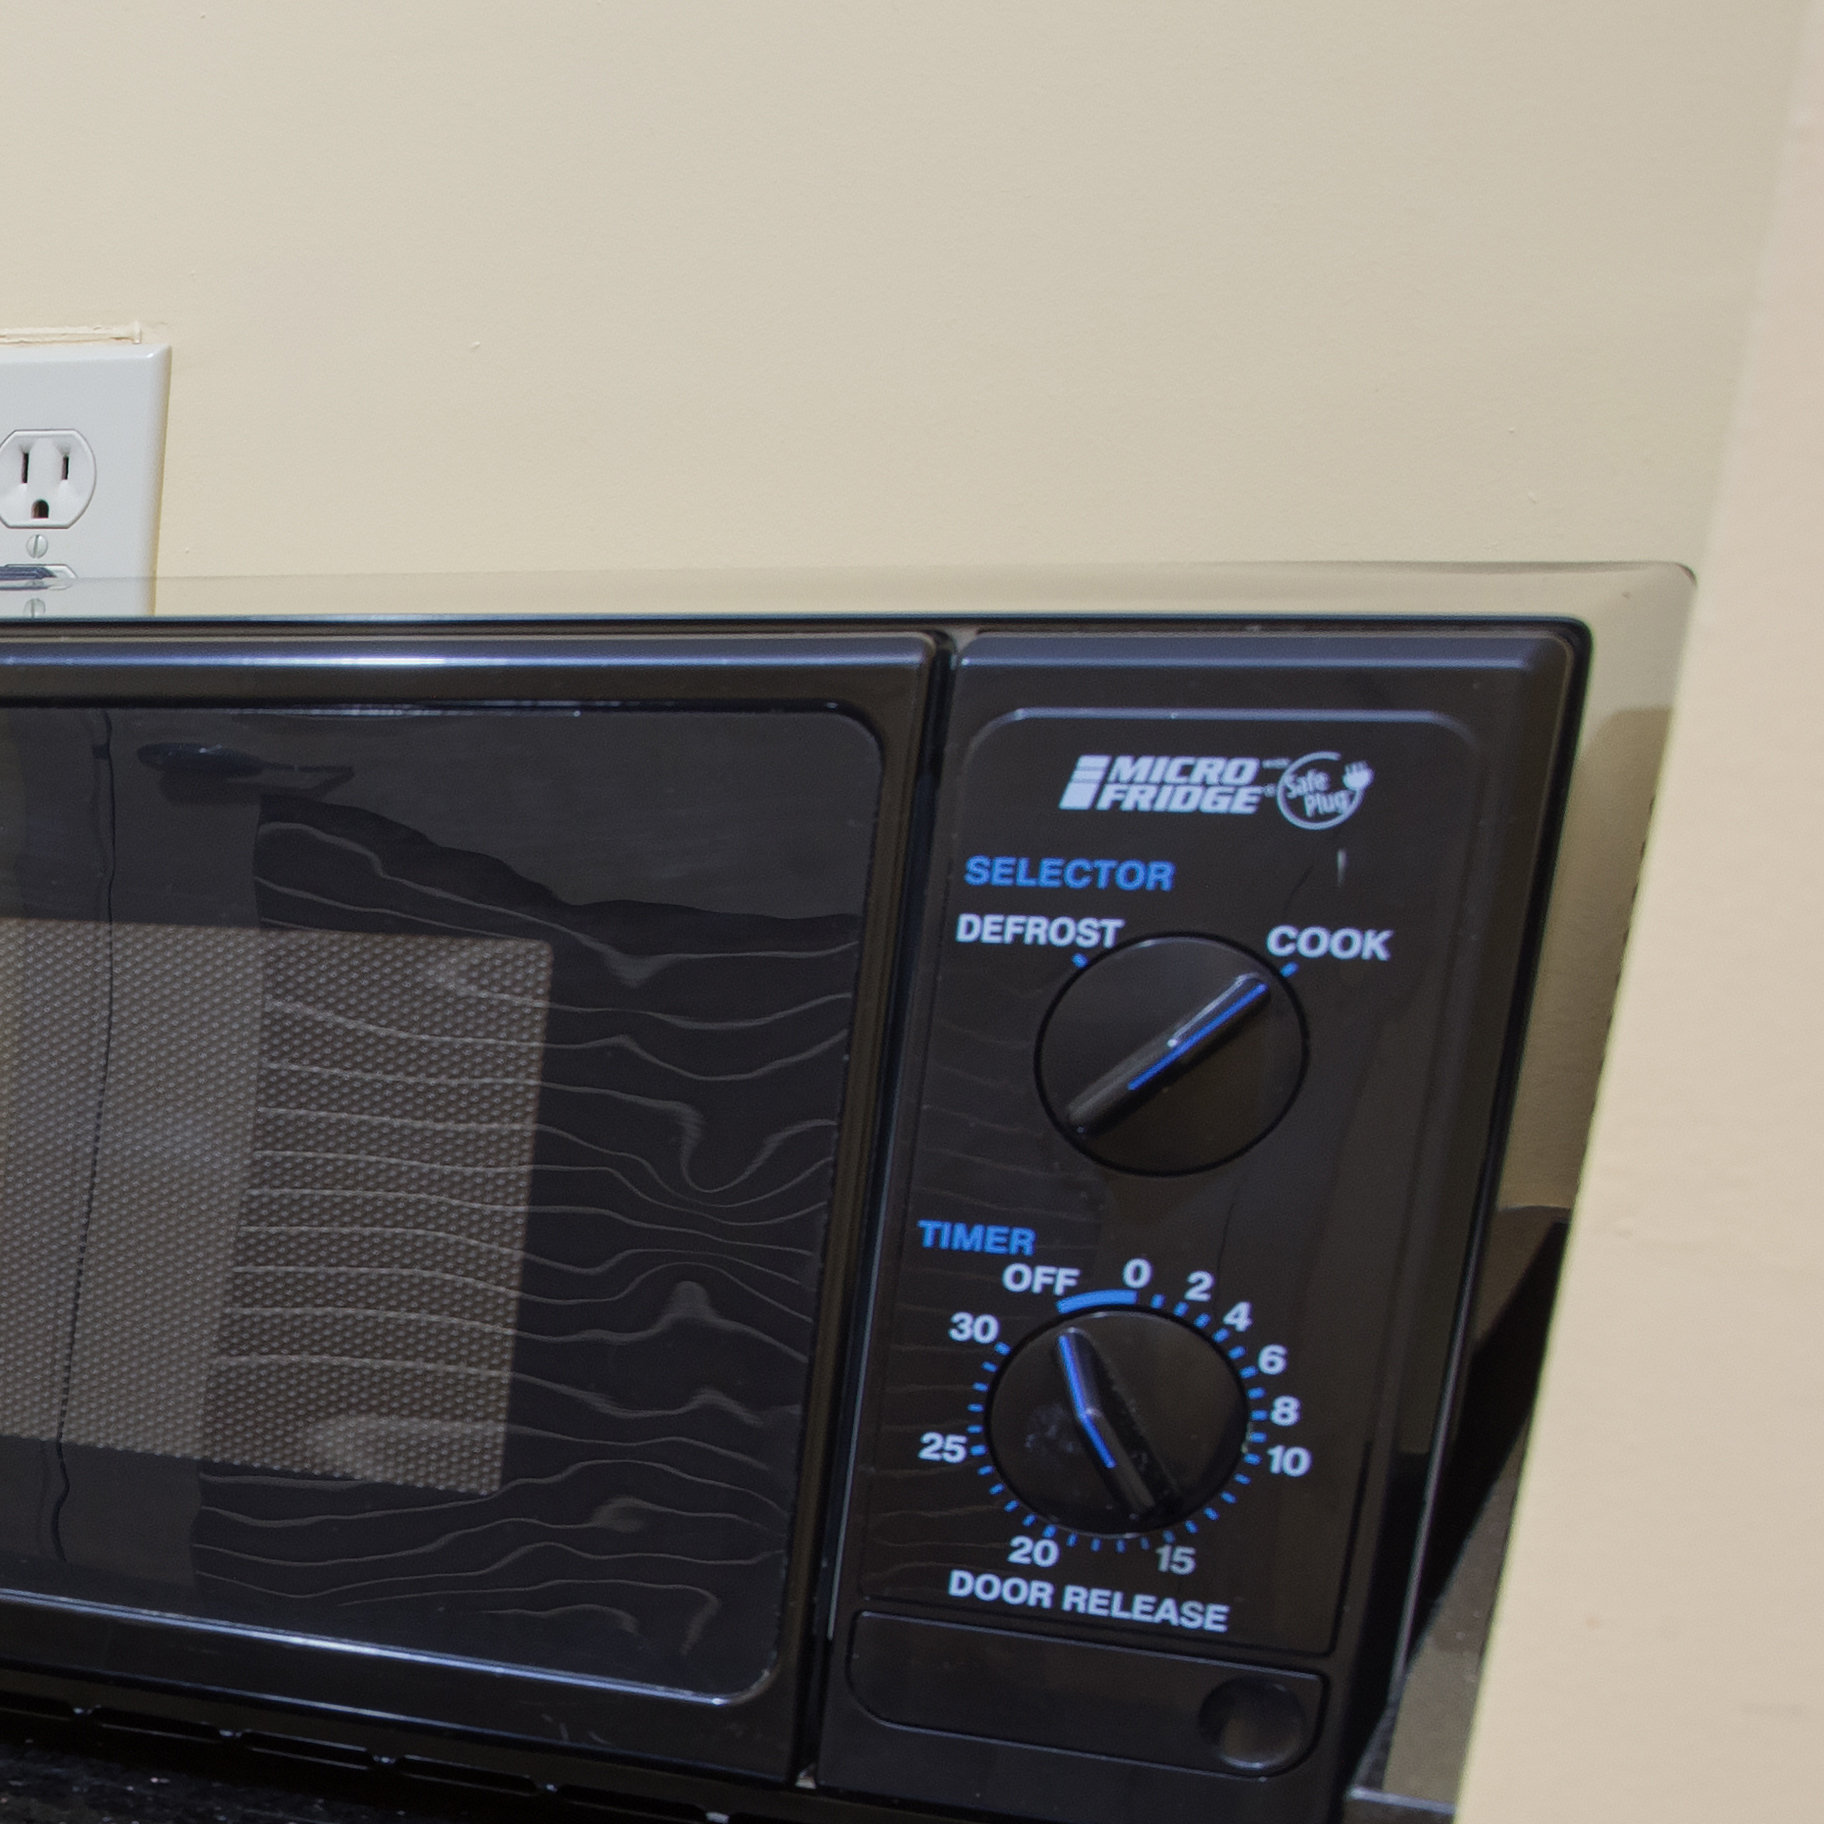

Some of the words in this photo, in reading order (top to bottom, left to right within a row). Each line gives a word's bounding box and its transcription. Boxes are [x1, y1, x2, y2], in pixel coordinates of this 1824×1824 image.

[1107, 756, 1260, 785] MICRO
[1285, 769, 1330, 798] Safe
[1096, 785, 1263, 814] FRIDGE
[1303, 790, 1349, 817] Plug
[965, 856, 1175, 892] SELECTOR
[956, 915, 1124, 948] DEFROST
[1266, 925, 1393, 961] COOK
[918, 1220, 1037, 1256] TIMER
[1002, 1264, 1080, 1297] OFF
[1124, 1258, 1151, 1288] 0
[1185, 1272, 1212, 1302] 2
[949, 1313, 999, 1344] 30
[1224, 1302, 1252, 1332] 4
[1258, 1345, 1287, 1375] 6
[1271, 1395, 1300, 1426] 8
[918, 1433, 968, 1464] 25
[1267, 1446, 1311, 1477] 10
[1008, 1537, 1059, 1568] 20
[1156, 1544, 1196, 1575] 15
[949, 1570, 1055, 1610] DOOR
[1062, 1585, 1230, 1633] RELEASE
